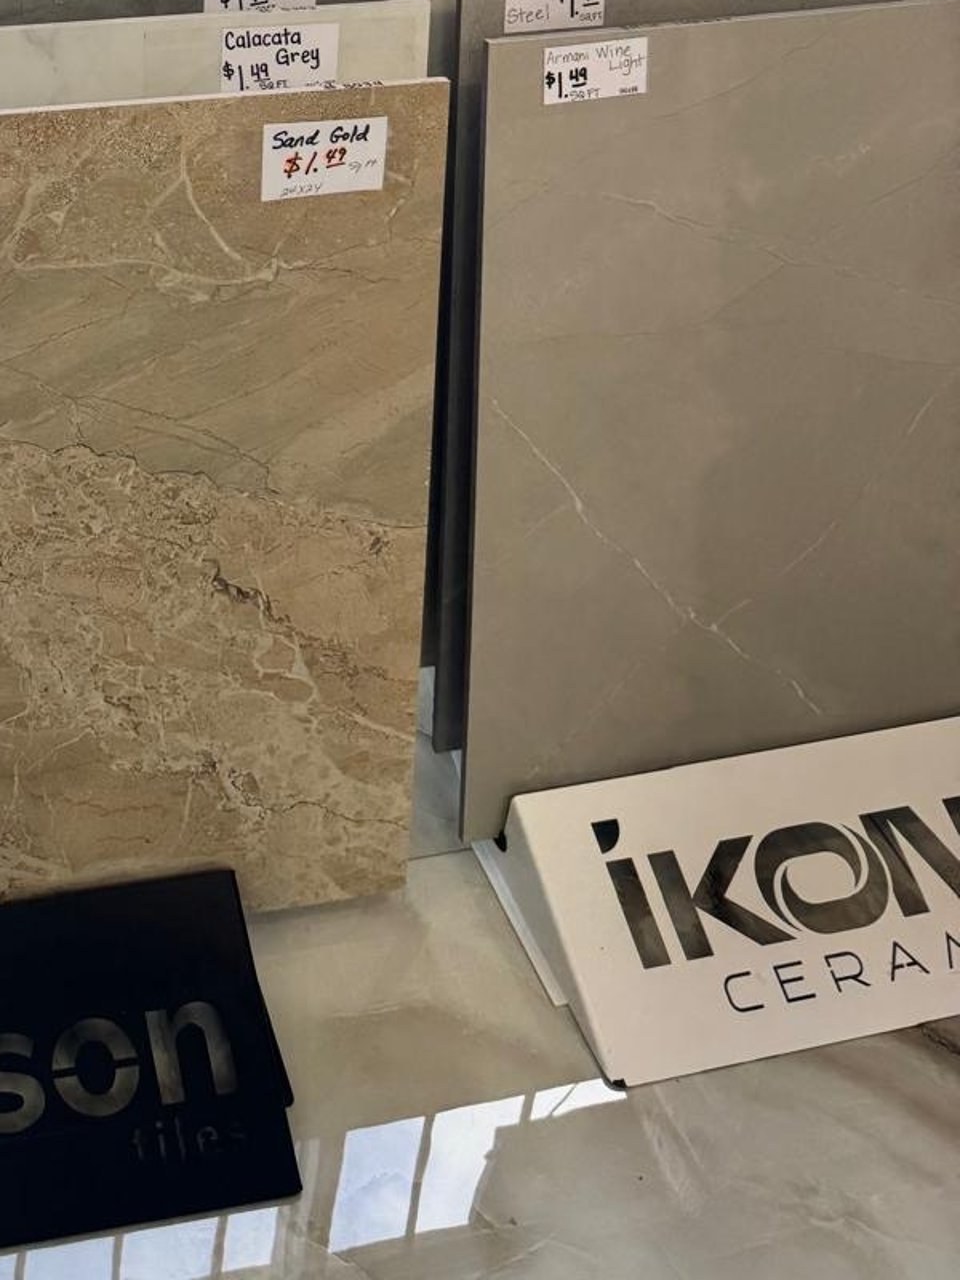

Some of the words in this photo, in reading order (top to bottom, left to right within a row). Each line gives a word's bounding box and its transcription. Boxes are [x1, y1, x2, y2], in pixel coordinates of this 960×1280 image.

[506, 3, 550, 24] Steel
[224, 27, 302, 51] Calacata
[275, 48, 320, 70] Grey
[595, 44, 631, 59] Wine
[609, 55, 646, 75] Light
[272, 129, 320, 150] Sand
[330, 123, 370, 144] Gold
